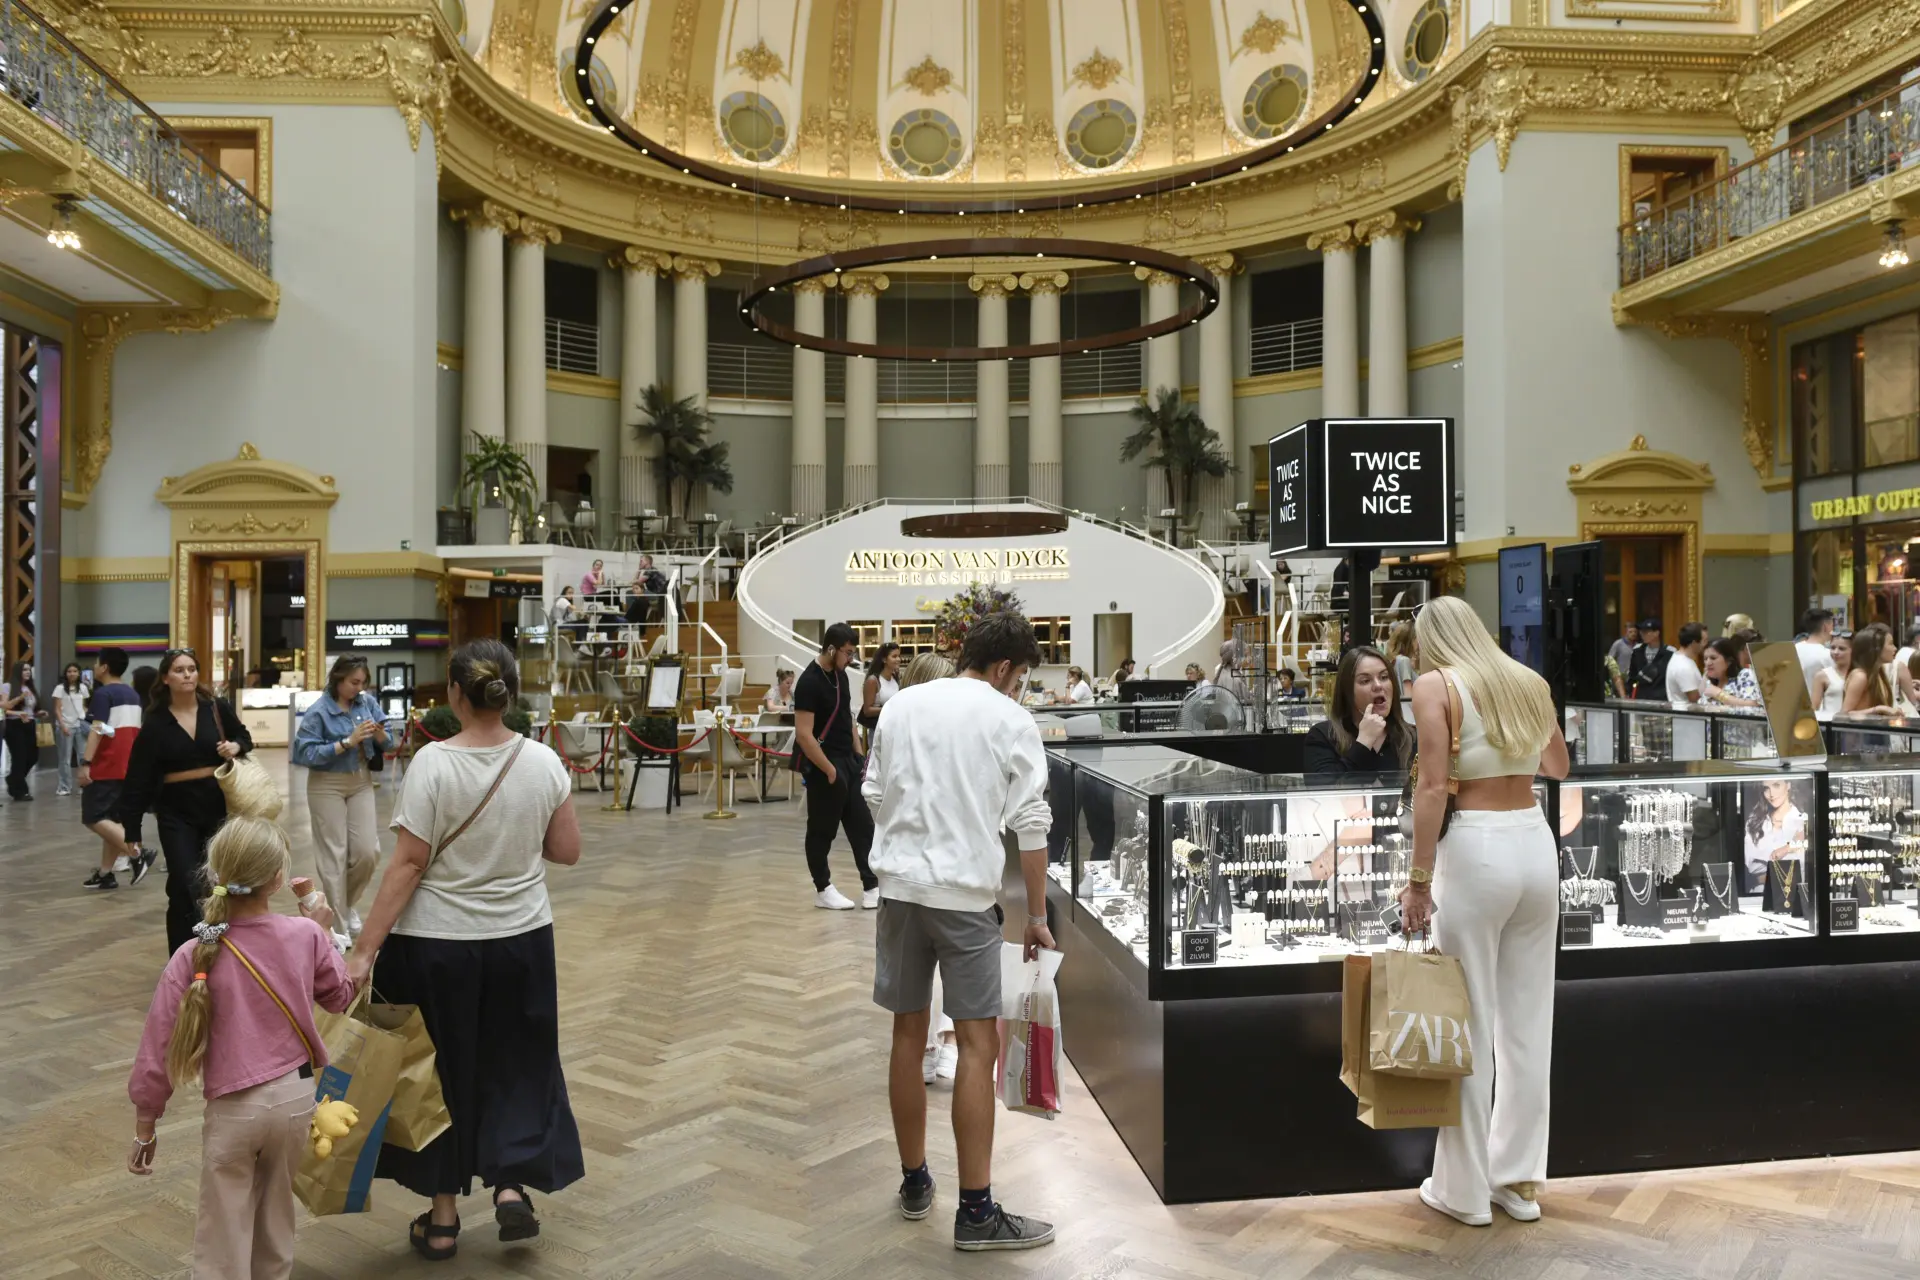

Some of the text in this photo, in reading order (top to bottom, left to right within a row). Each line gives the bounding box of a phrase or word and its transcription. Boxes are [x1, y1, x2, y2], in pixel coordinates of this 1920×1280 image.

[1277, 459, 1299, 483] TWICE
[1351, 452, 1421, 471] TWICE
[1283, 483, 1293, 502] AS
[1373, 474, 1400, 492] AS
[1280, 503, 1297, 523] NICE
[1362, 495, 1412, 514] NICE
[1811, 495, 1871, 520] URBAN
[847, 547, 1068, 570] ANTOON VAN DYCK
[899, 571, 1011, 585] BRASSERIE
[494, 586, 506, 594] WC
[336, 624, 408, 635] WATCH STORE
[1190, 937, 1210, 945] GOUD
[1189, 952, 1210, 960] ZILVER
[1388, 1011, 1473, 1067] ZARA
[1026, 1022, 1034, 1099] www.visitantwerpen.be
